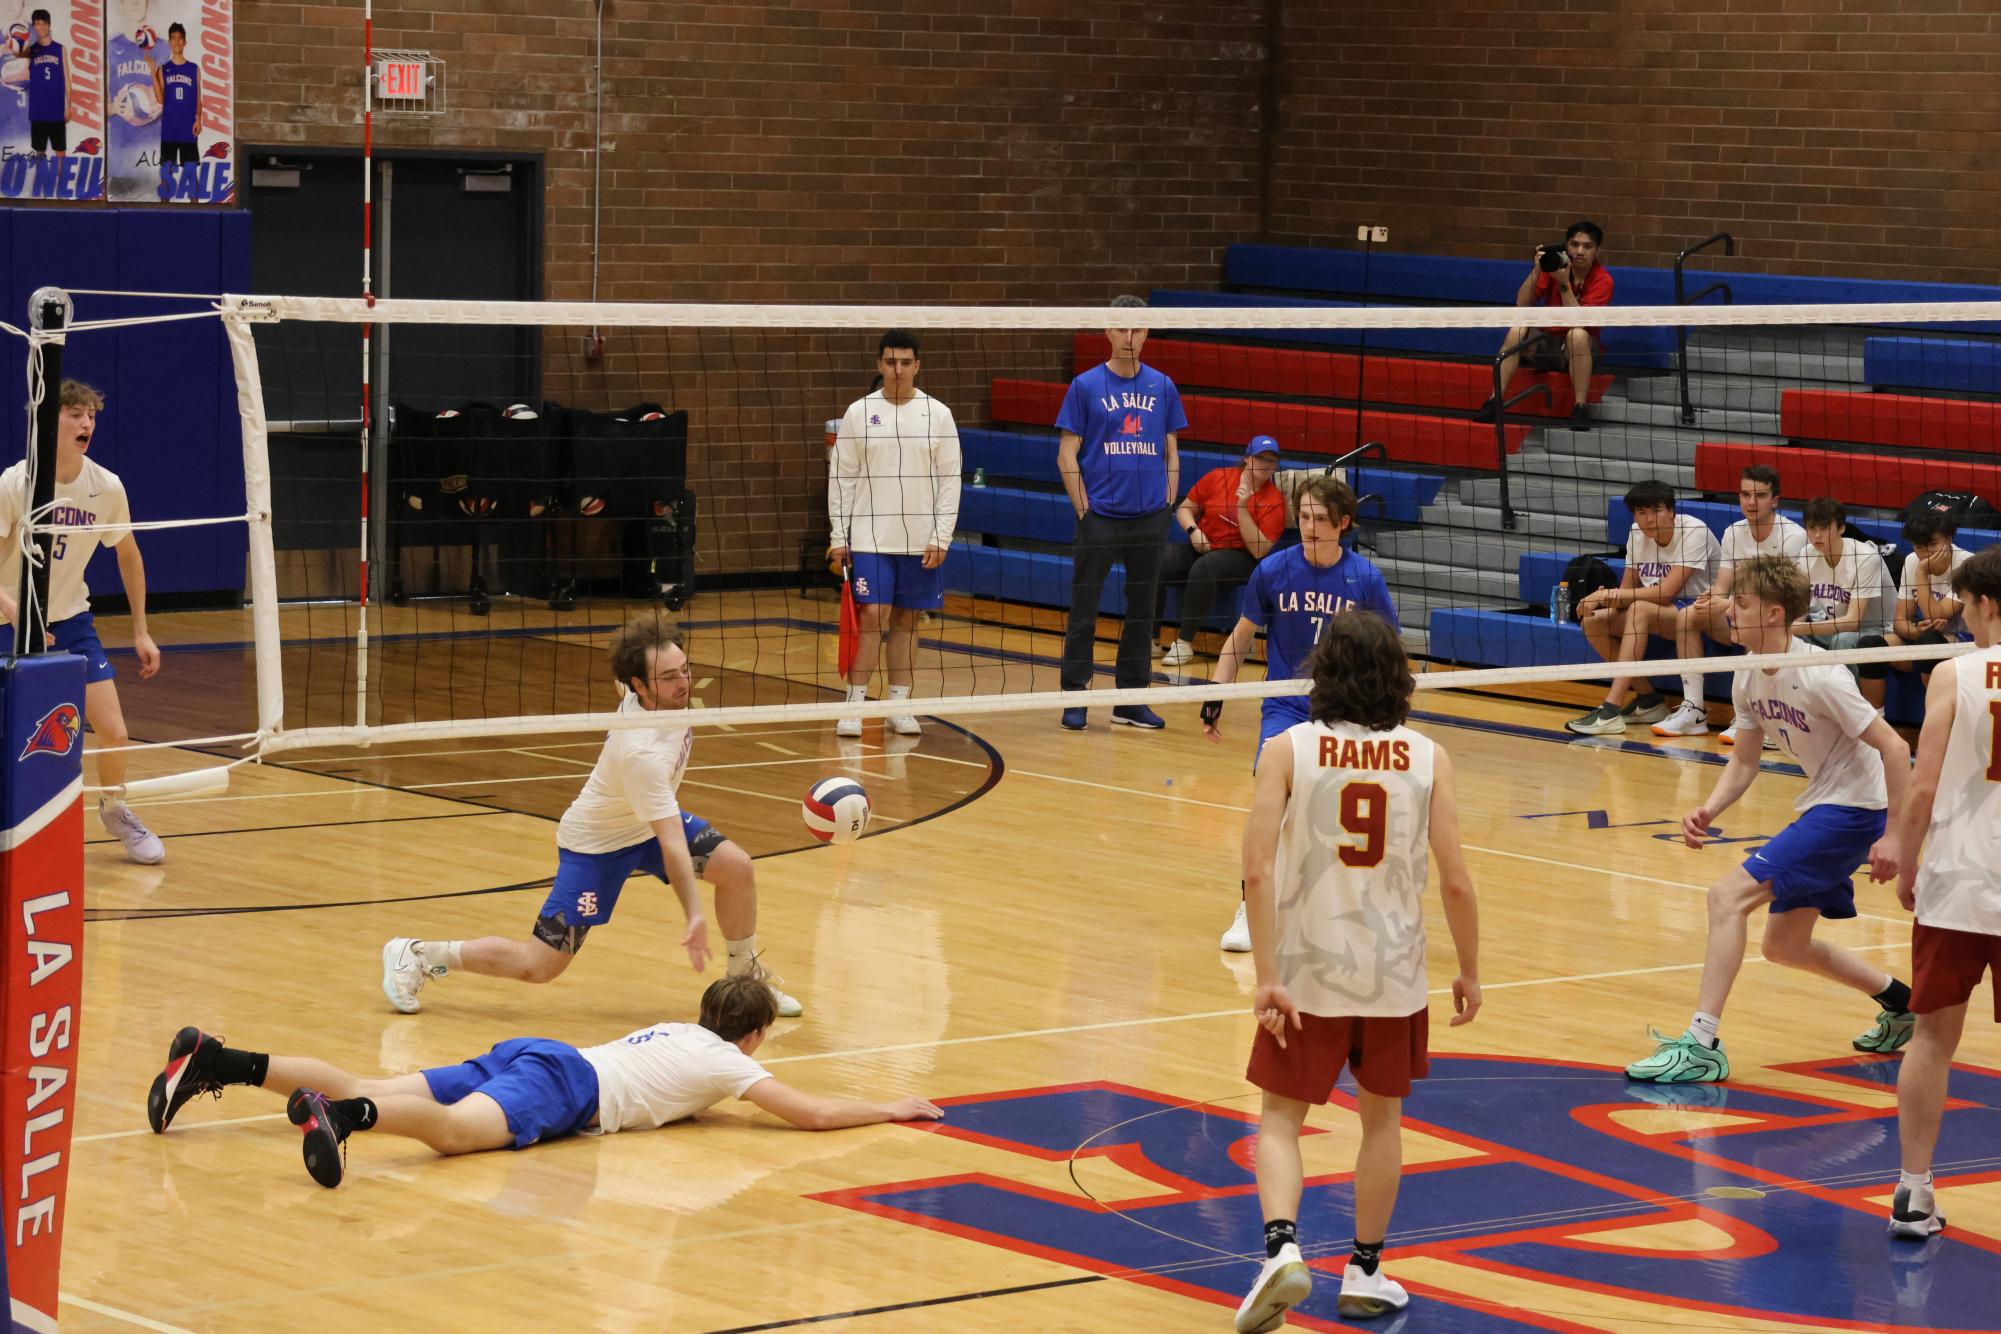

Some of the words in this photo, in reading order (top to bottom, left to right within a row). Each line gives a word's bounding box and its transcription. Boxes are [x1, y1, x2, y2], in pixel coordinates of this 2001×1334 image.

[69, 0, 102, 132] FALCON
[117, 60, 153, 78] FALCO
[387, 63, 420, 97] EXIT
[157, 161, 231, 201] SALE
[1101, 394, 1120, 412] LA
[1121, 392, 1157, 412] SALLE
[1103, 441, 1158, 456] VOLLEYBALL
[53, 506, 97, 531] CONS
[52, 534, 68, 560] 5
[1279, 591, 1299, 613] LA
[1310, 616, 1324, 645] 7
[1318, 735, 1410, 772] RAMS
[1336, 779, 1389, 869] 9
[21, 889, 73, 987] LA
[15, 1004, 72, 1248] SALLE
